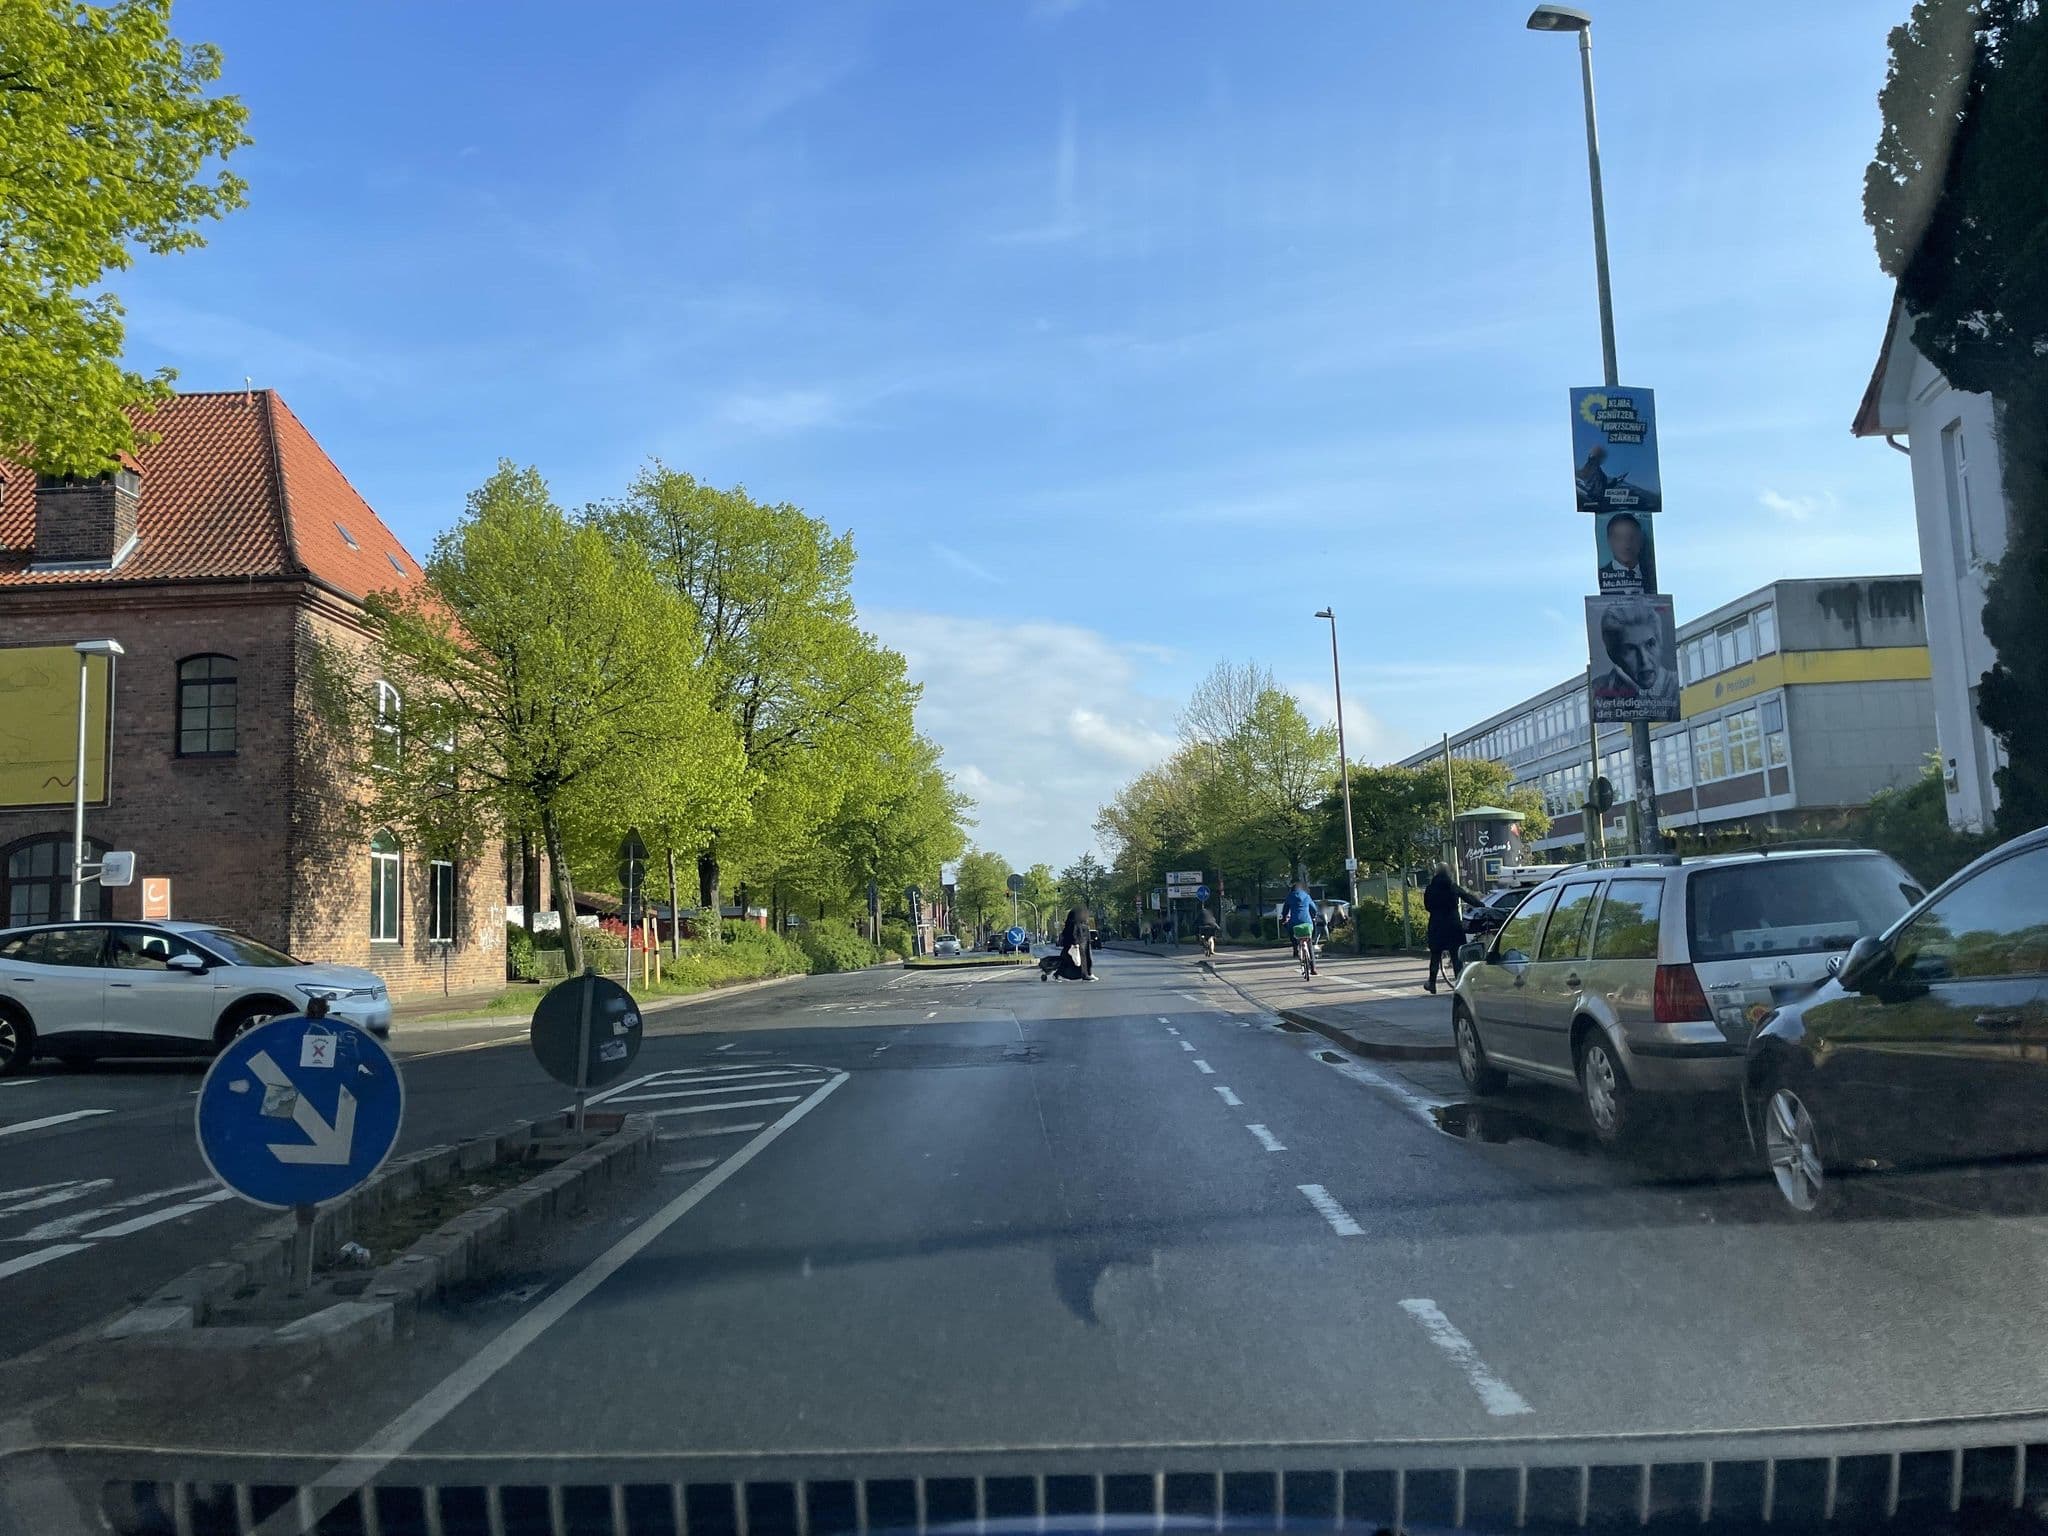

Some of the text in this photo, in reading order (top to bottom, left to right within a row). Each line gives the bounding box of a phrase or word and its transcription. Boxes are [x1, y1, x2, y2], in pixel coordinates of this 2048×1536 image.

[1602, 571, 1626, 579] David
[1602, 580, 1642, 588] McAllister
[1597, 709, 1612, 718] der
